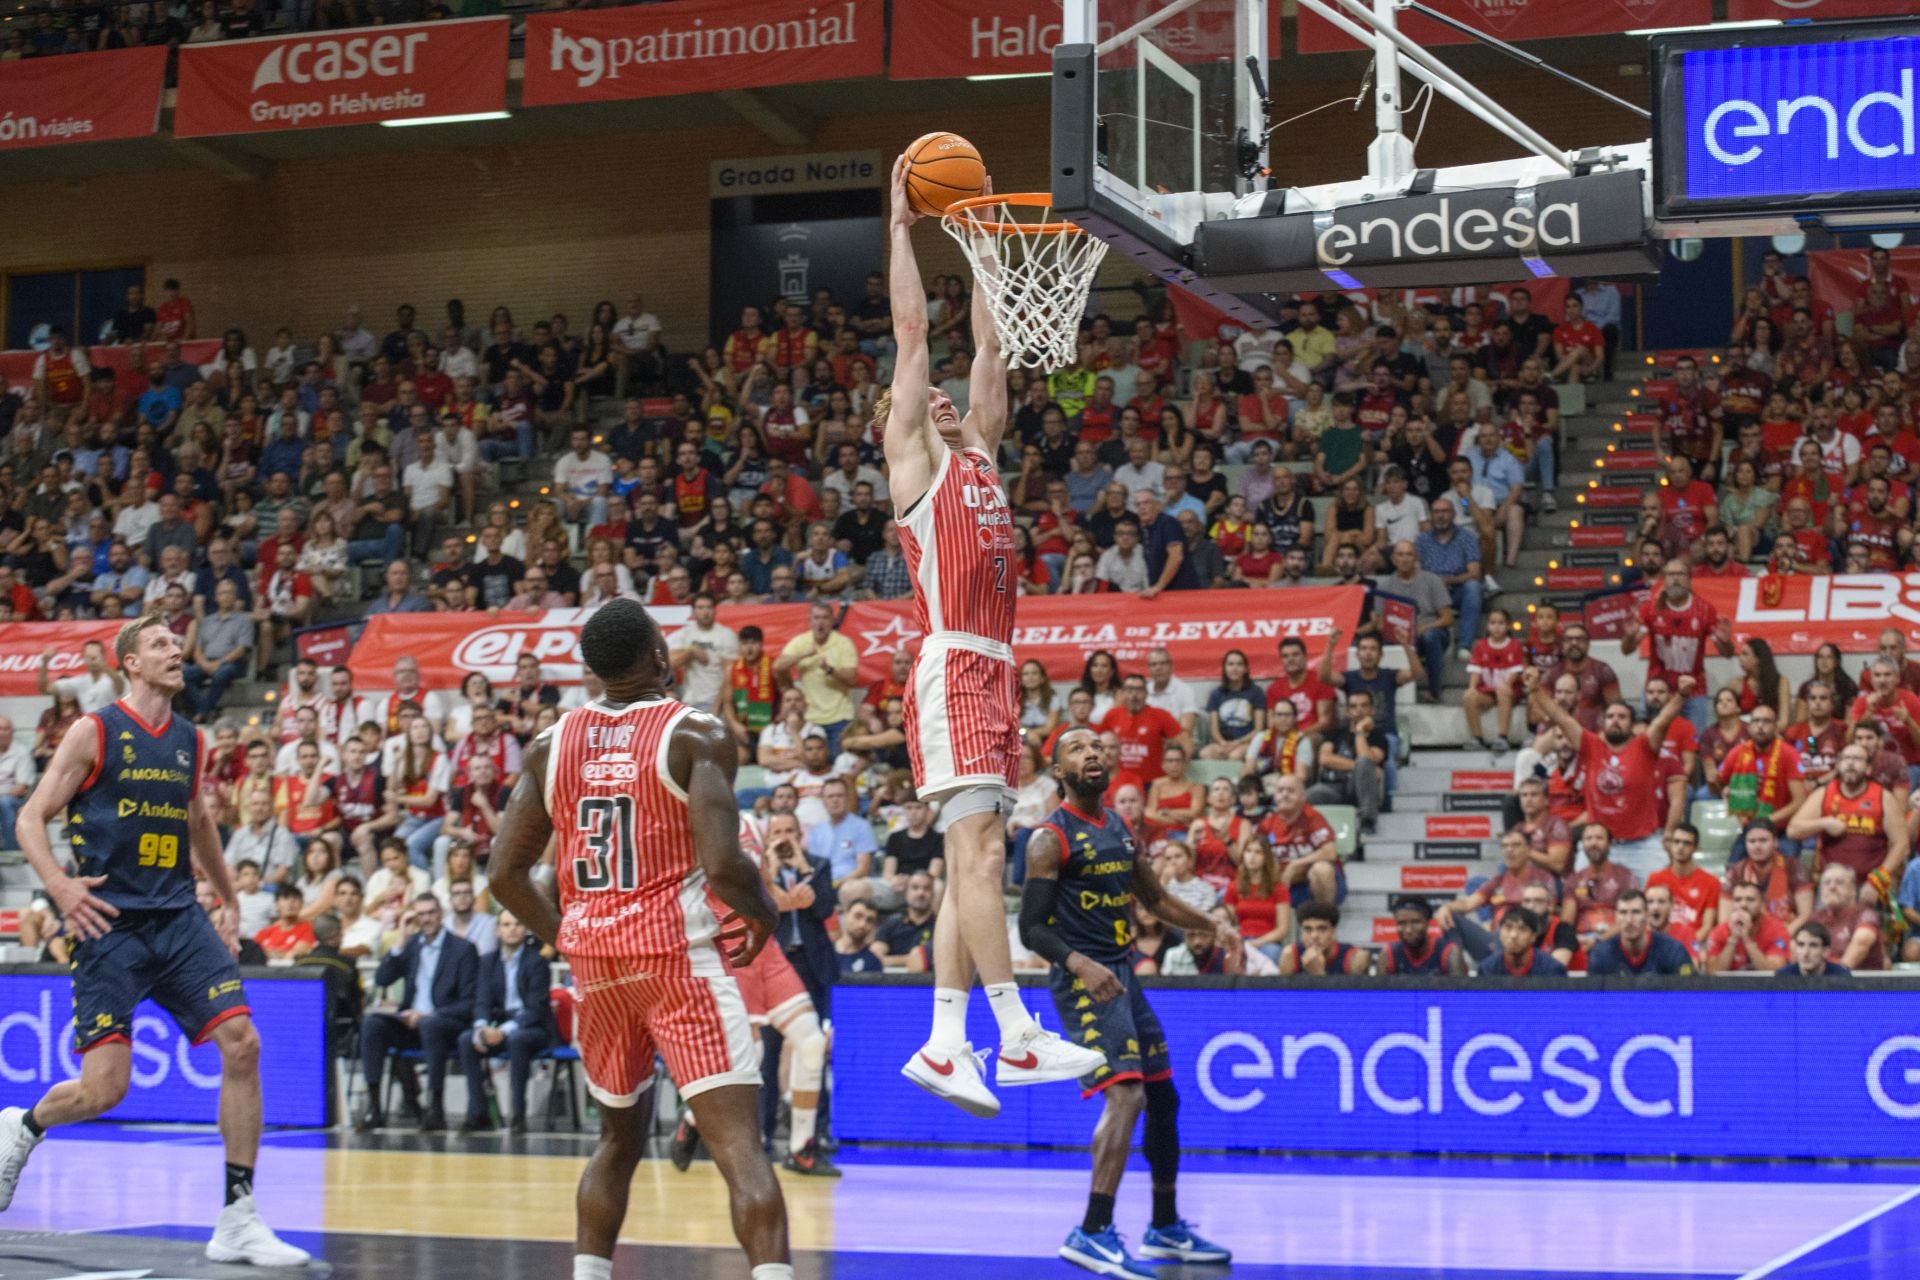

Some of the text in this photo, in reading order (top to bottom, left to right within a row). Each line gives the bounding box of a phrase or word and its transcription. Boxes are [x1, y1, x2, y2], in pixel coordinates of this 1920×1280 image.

[286, 31, 429, 84] caser
[606, 3, 857, 79] patrimonial
[40, 117, 94, 138] viajes
[250, 88, 426, 125] Grupo Helvetia
[1704, 68, 1915, 166] end
[718, 159, 874, 187] Grada Norte
[1316, 198, 1580, 266] endesa
[993, 555, 1007, 593] 2
[1151, 617, 1334, 641] LEVANTE
[138, 833, 178, 868] 99
[573, 793, 638, 892] 31
[1196, 1006, 1694, 1118] endesa
